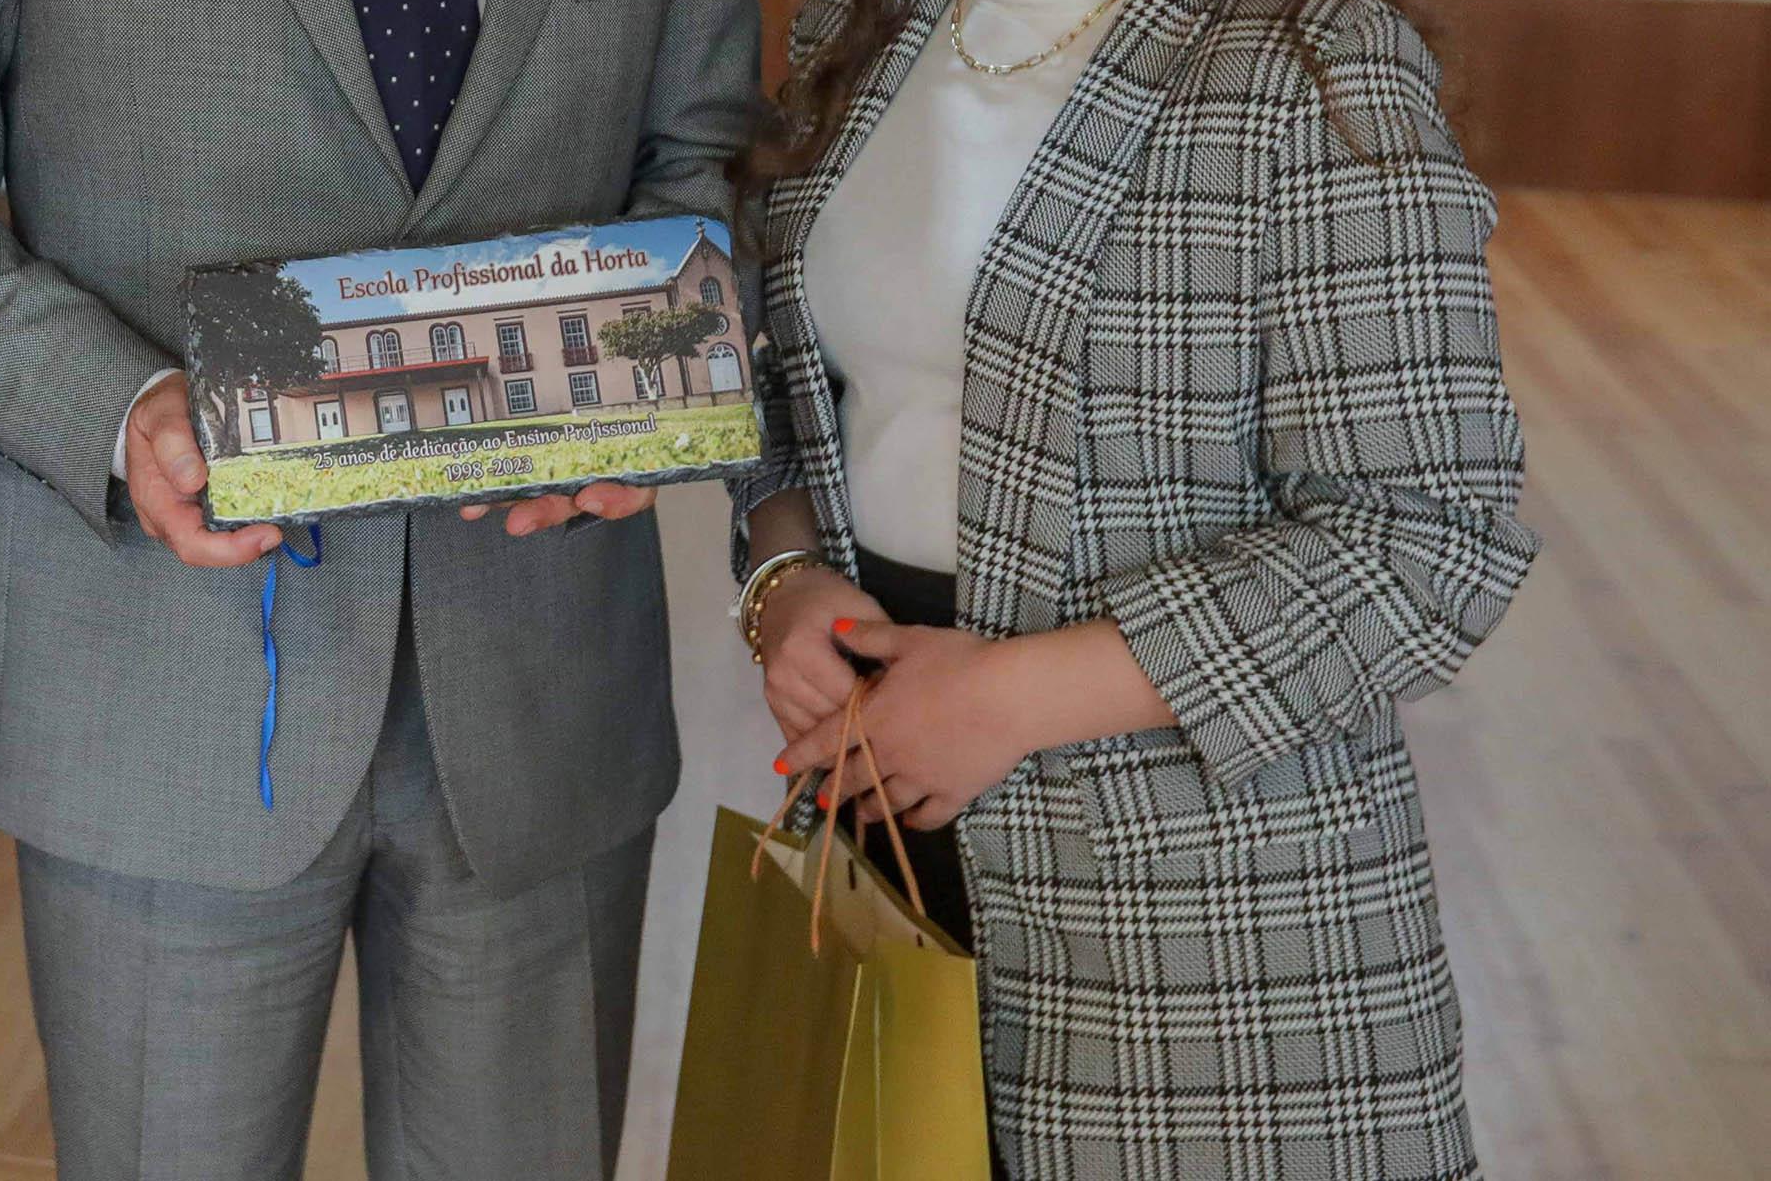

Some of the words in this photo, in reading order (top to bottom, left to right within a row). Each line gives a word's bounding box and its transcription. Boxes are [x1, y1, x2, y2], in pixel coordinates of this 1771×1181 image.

[337, 270, 409, 299] Escola
[413, 254, 546, 295] Profissional
[551, 251, 578, 276] da
[583, 247, 650, 274] Horta
[314, 452, 334, 469] 25
[338, 450, 376, 467] anos
[380, 443, 398, 462] de
[402, 435, 478, 459] dedicação
[482, 438, 502, 451] ao
[505, 429, 560, 448] Ensino
[564, 414, 657, 444] Profissional
[447, 462, 484, 482] 1998
